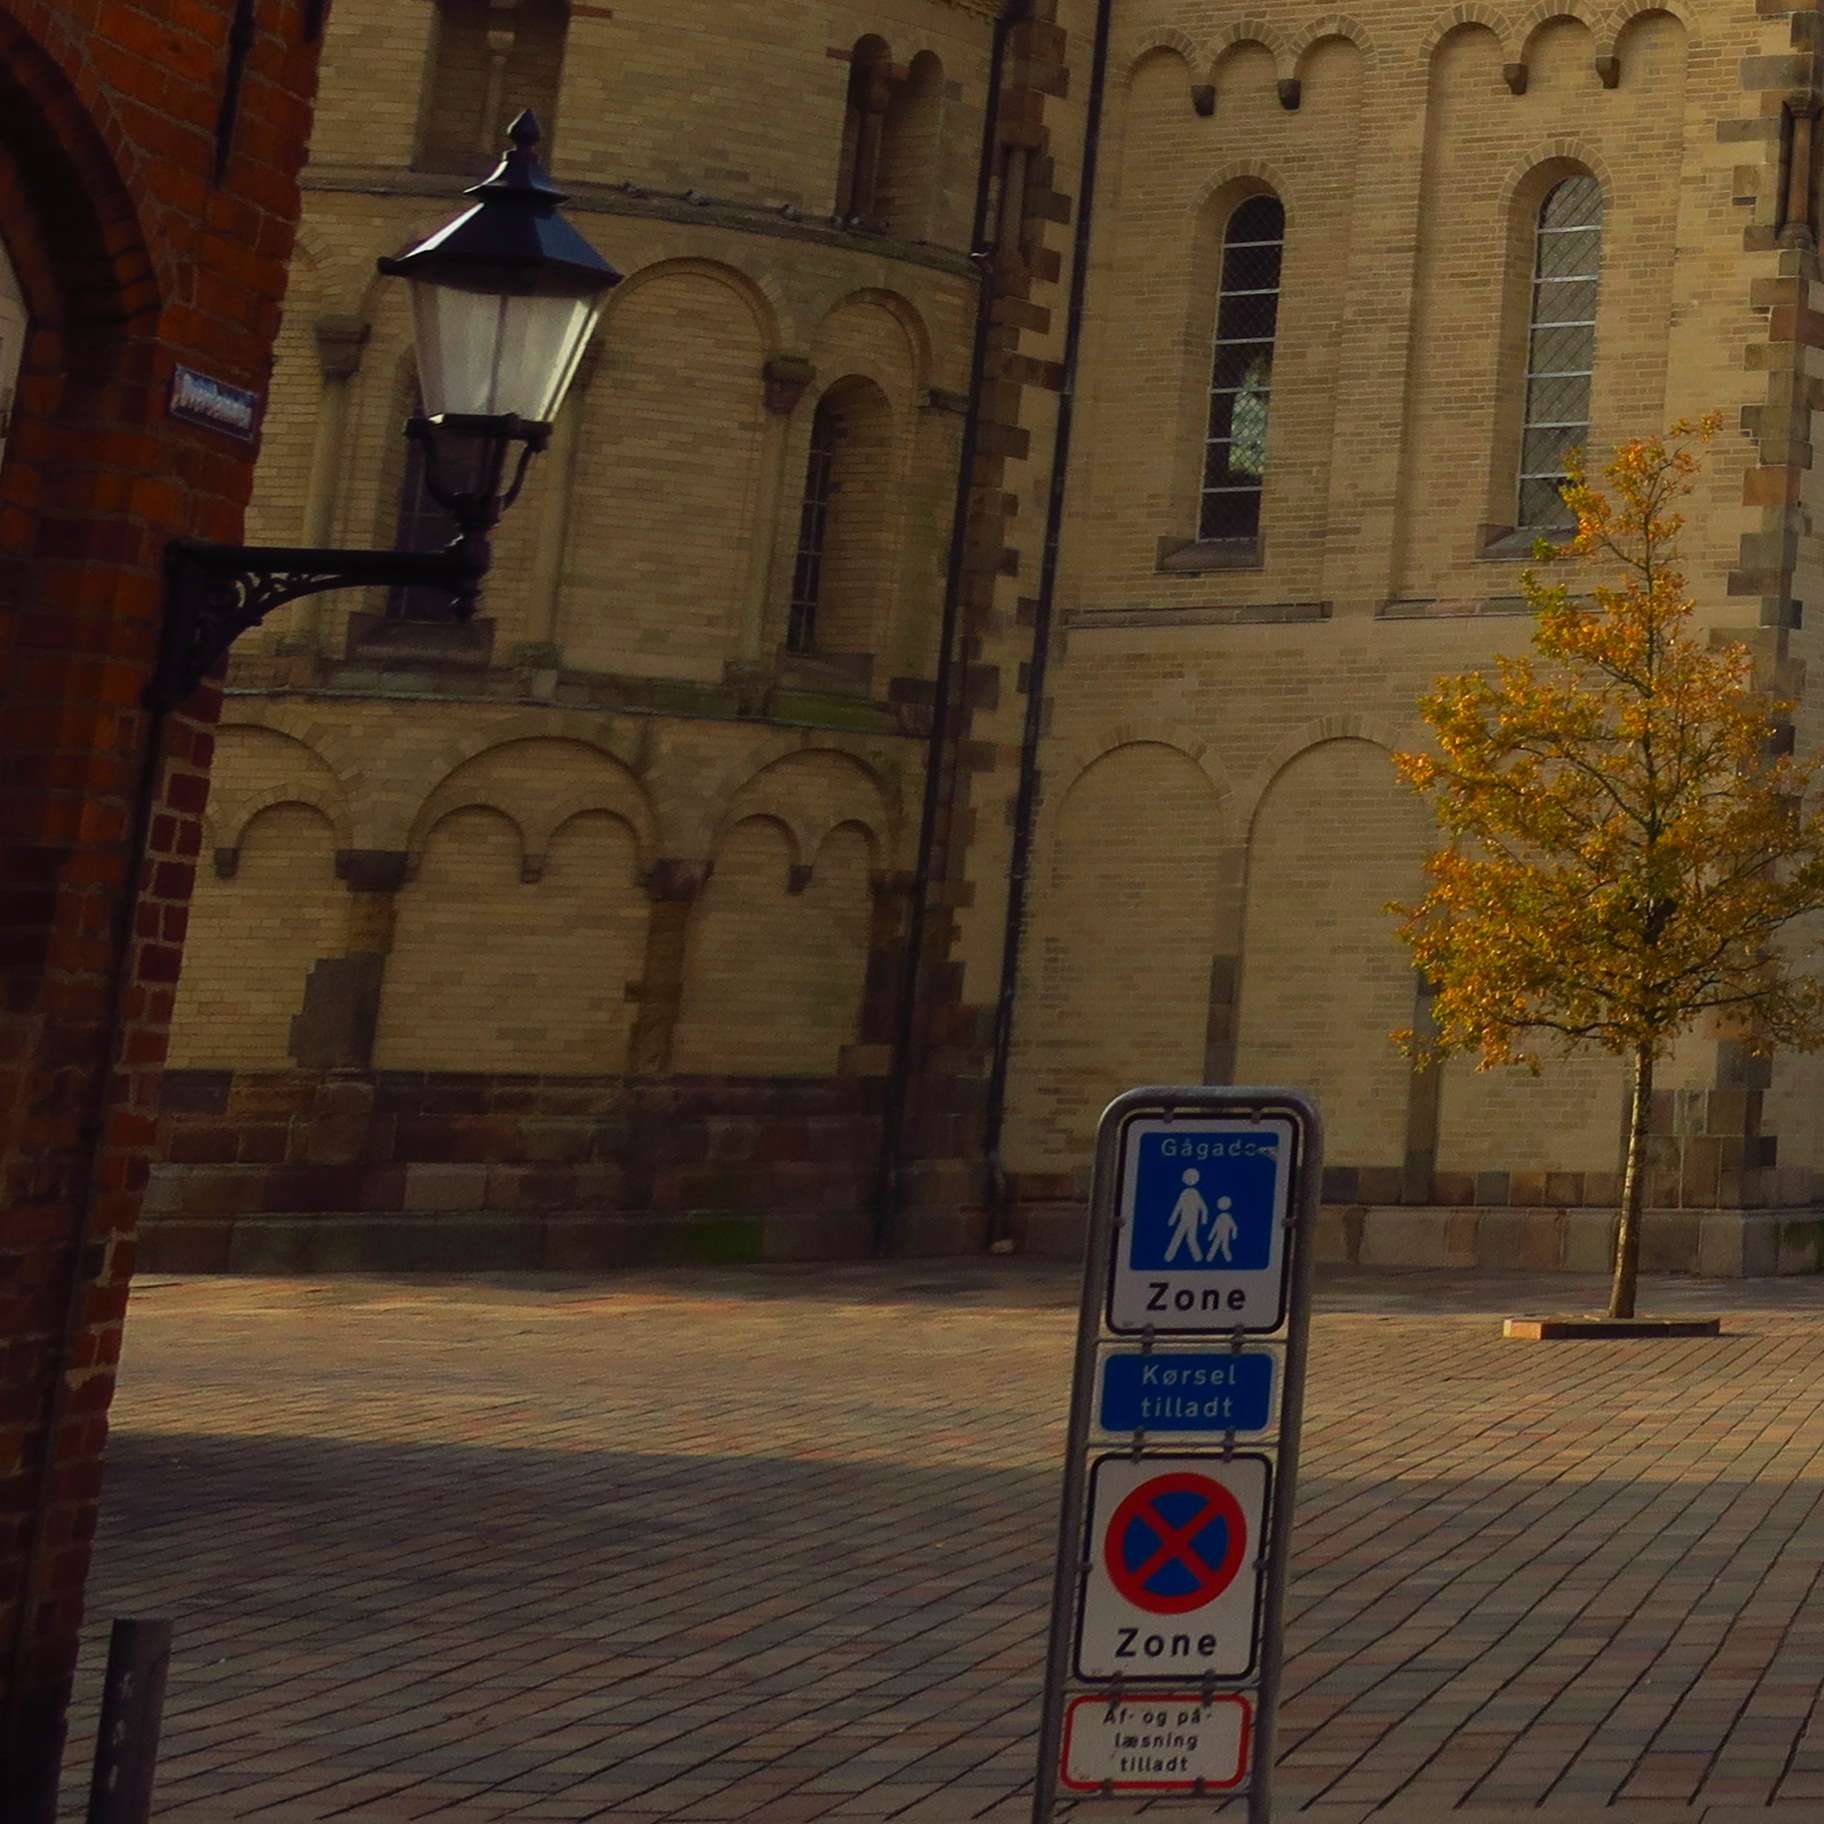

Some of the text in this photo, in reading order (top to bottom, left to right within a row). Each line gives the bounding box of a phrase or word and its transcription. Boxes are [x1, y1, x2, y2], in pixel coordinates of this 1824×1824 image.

[1146, 1282, 1247, 1312] Zone
[1141, 1364, 1237, 1386] Kørsel
[1140, 1395, 1234, 1419] tilladt
[1115, 1628, 1217, 1658] Zone
[1142, 1710, 1167, 1726] og
[1114, 1732, 1199, 1751] læsning
[1120, 1756, 1189, 1773] tilladt
